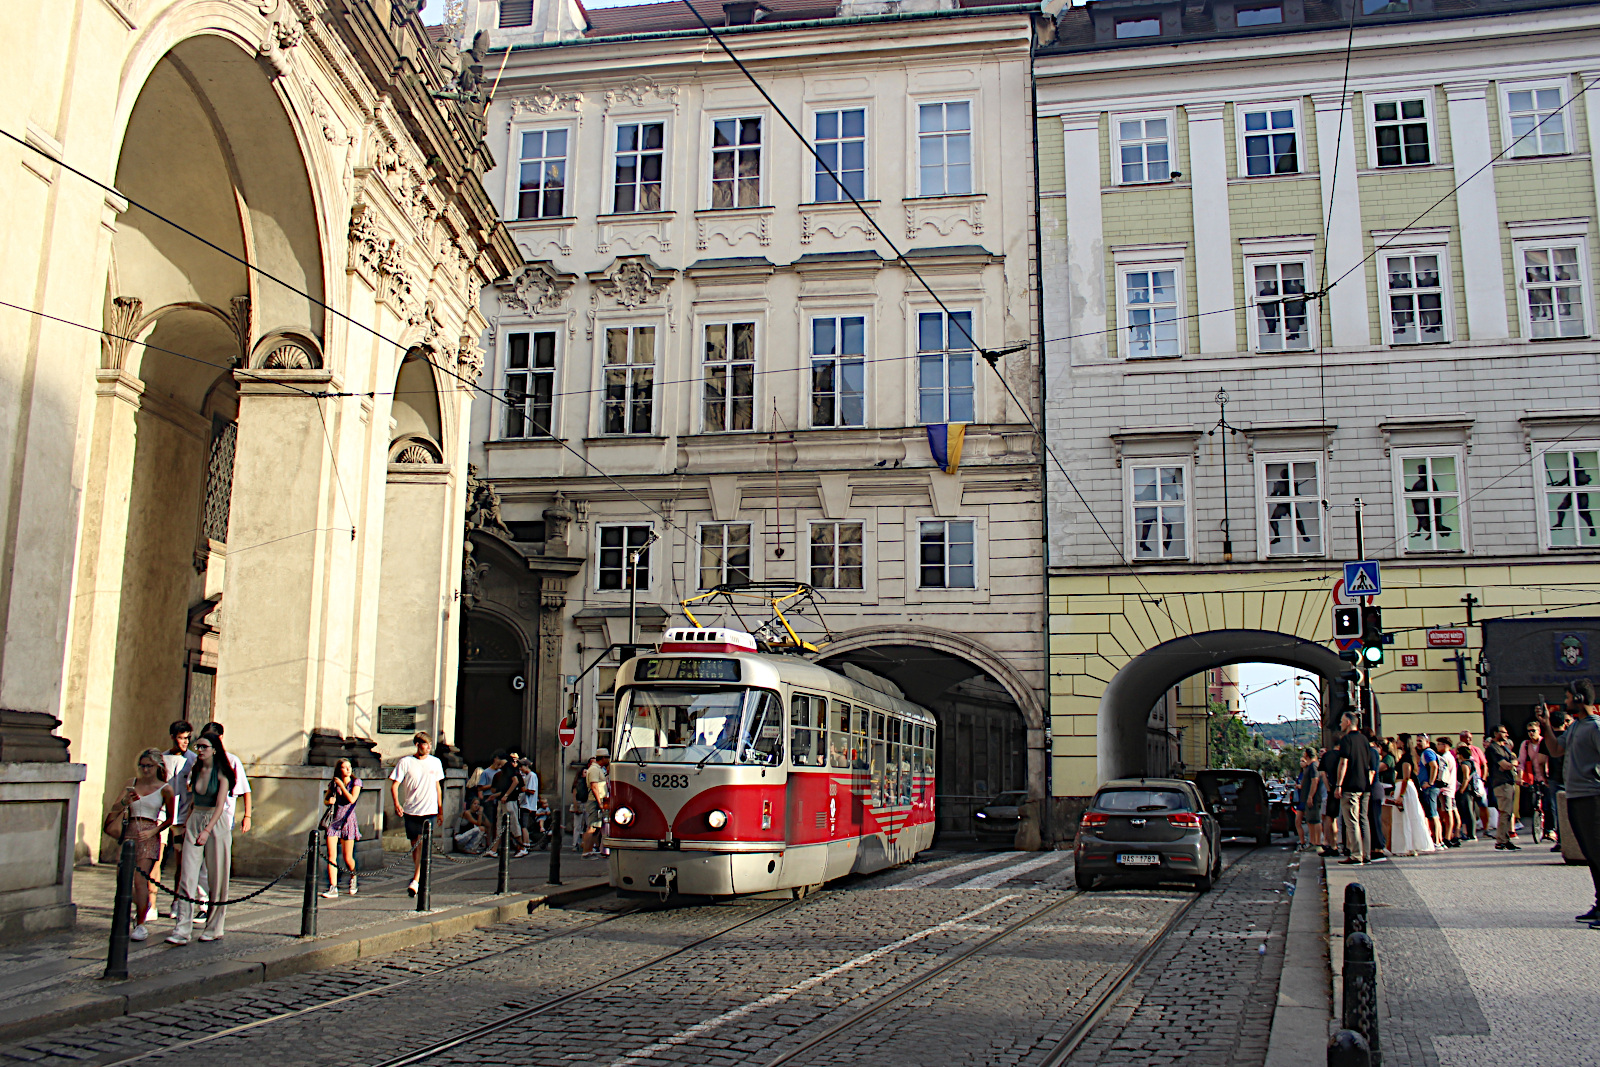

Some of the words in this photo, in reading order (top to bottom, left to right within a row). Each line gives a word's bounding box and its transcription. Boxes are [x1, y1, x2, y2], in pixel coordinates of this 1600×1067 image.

[647, 660, 659, 678] 2
[512, 675, 525, 690] G
[652, 774, 689, 789] 8283
